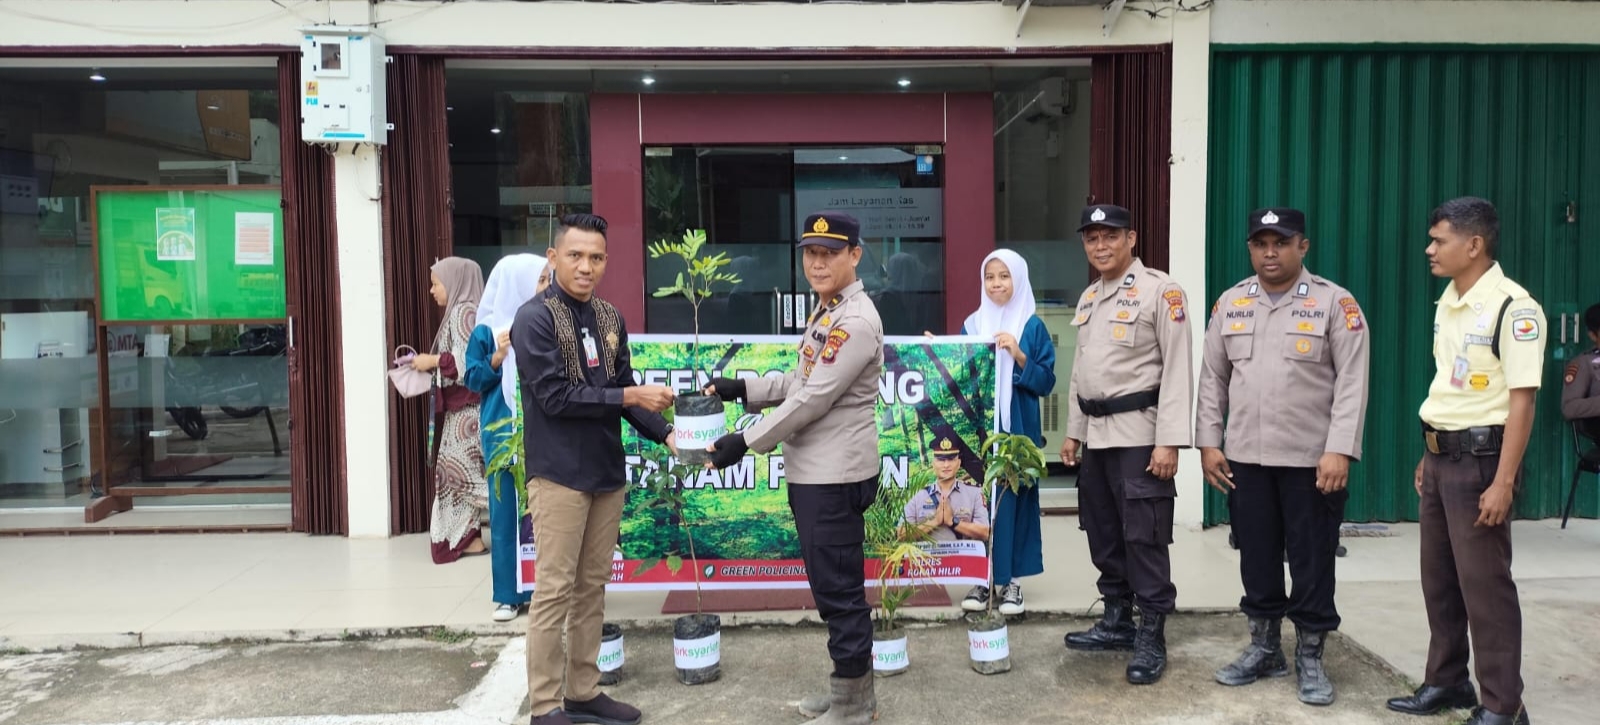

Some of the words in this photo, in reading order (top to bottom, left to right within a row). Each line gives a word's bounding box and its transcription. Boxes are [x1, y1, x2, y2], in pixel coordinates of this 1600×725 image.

[851, 197, 893, 207] Layanan
[1116, 298, 1141, 307] POLRI
[1226, 310, 1254, 319] NURLIS
[1291, 310, 1324, 318] POLRI
[721, 565, 756, 576] GREEN
[938, 567, 961, 575] HILIR
